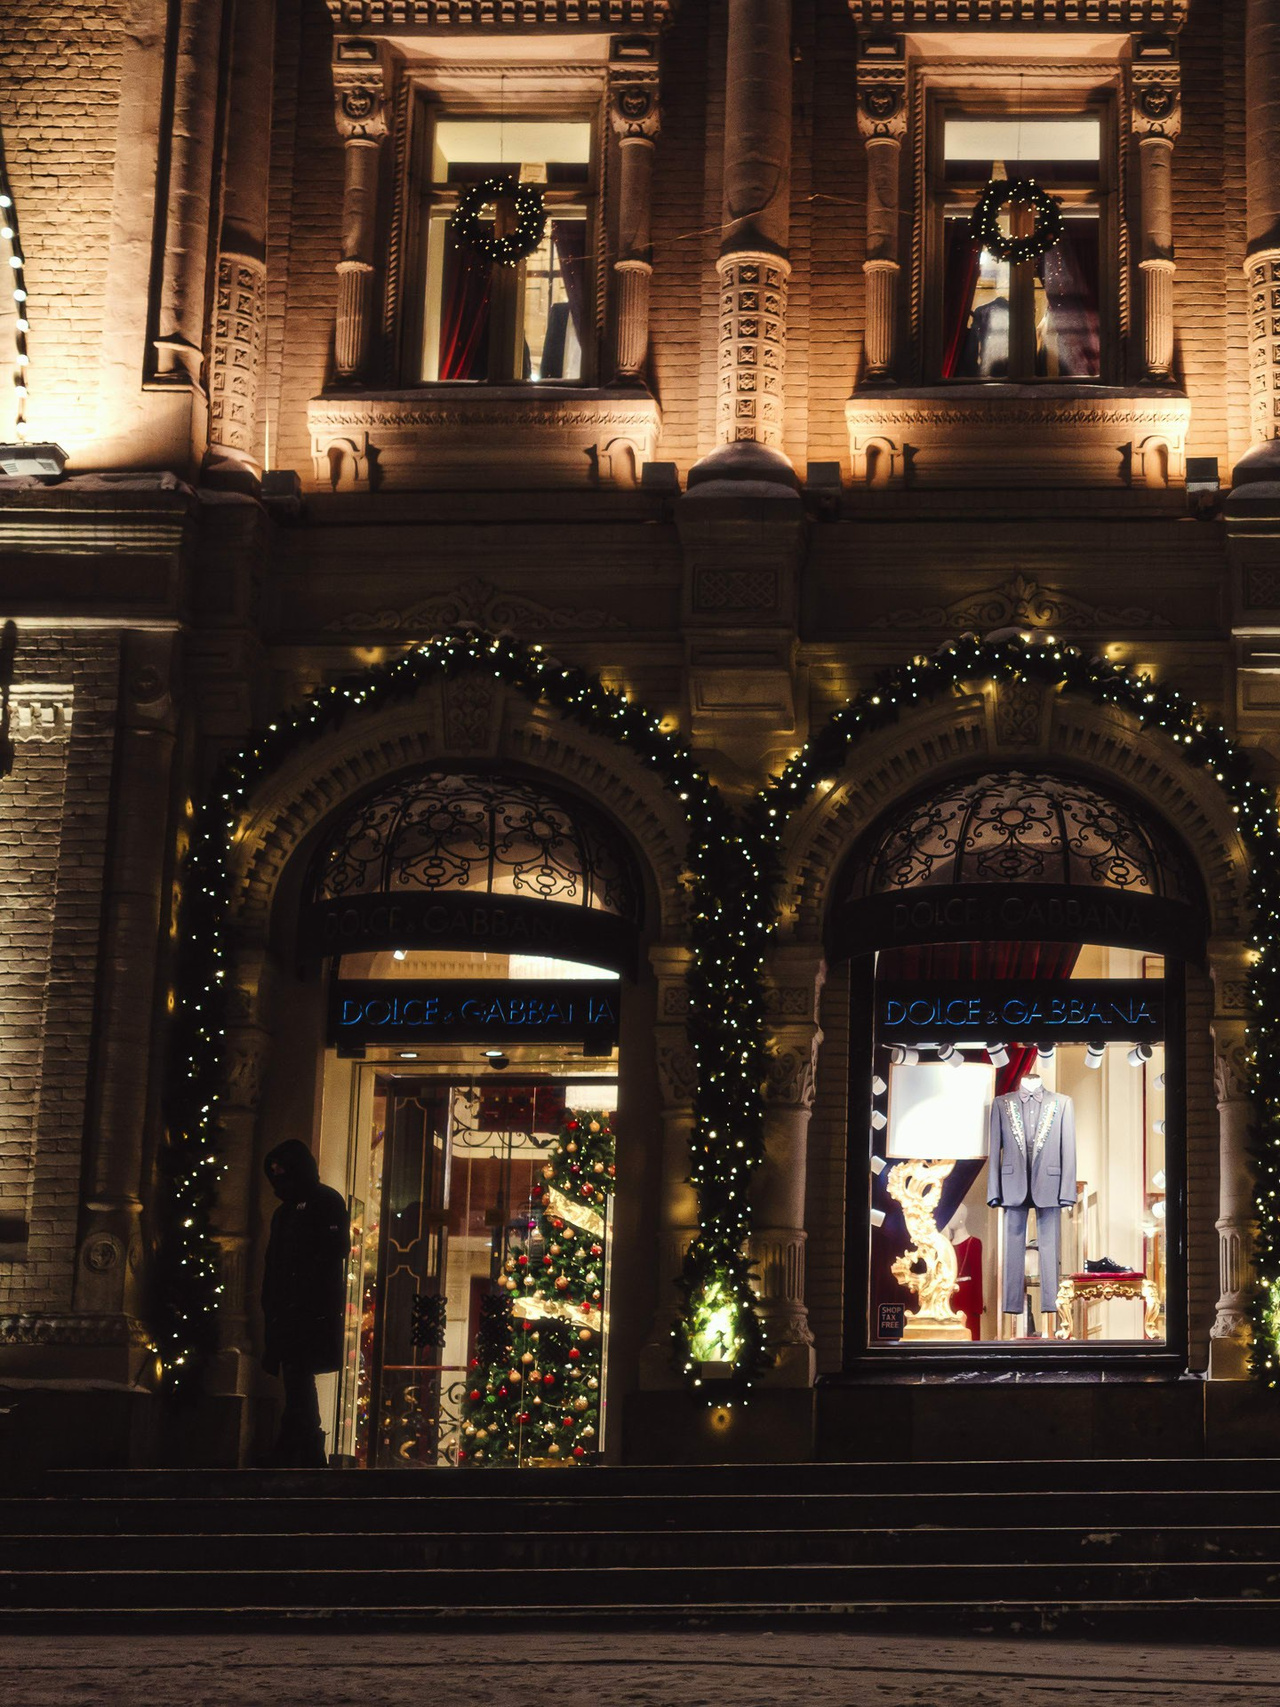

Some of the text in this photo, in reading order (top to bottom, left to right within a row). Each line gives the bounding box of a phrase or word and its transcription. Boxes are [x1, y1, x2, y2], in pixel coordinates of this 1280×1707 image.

[324, 906, 401, 938] DOLCE
[893, 899, 977, 931] DOLCE
[1000, 898, 1143, 934] GABBANA
[340, 997, 439, 1026] DOLCE
[461, 997, 615, 1025] GABBANA
[883, 998, 980, 1025] DOLCE
[1001, 998, 1156, 1025] GABBANA
[882, 1306, 901, 1314] SHOP
[881, 1321, 899, 1329] FREE
